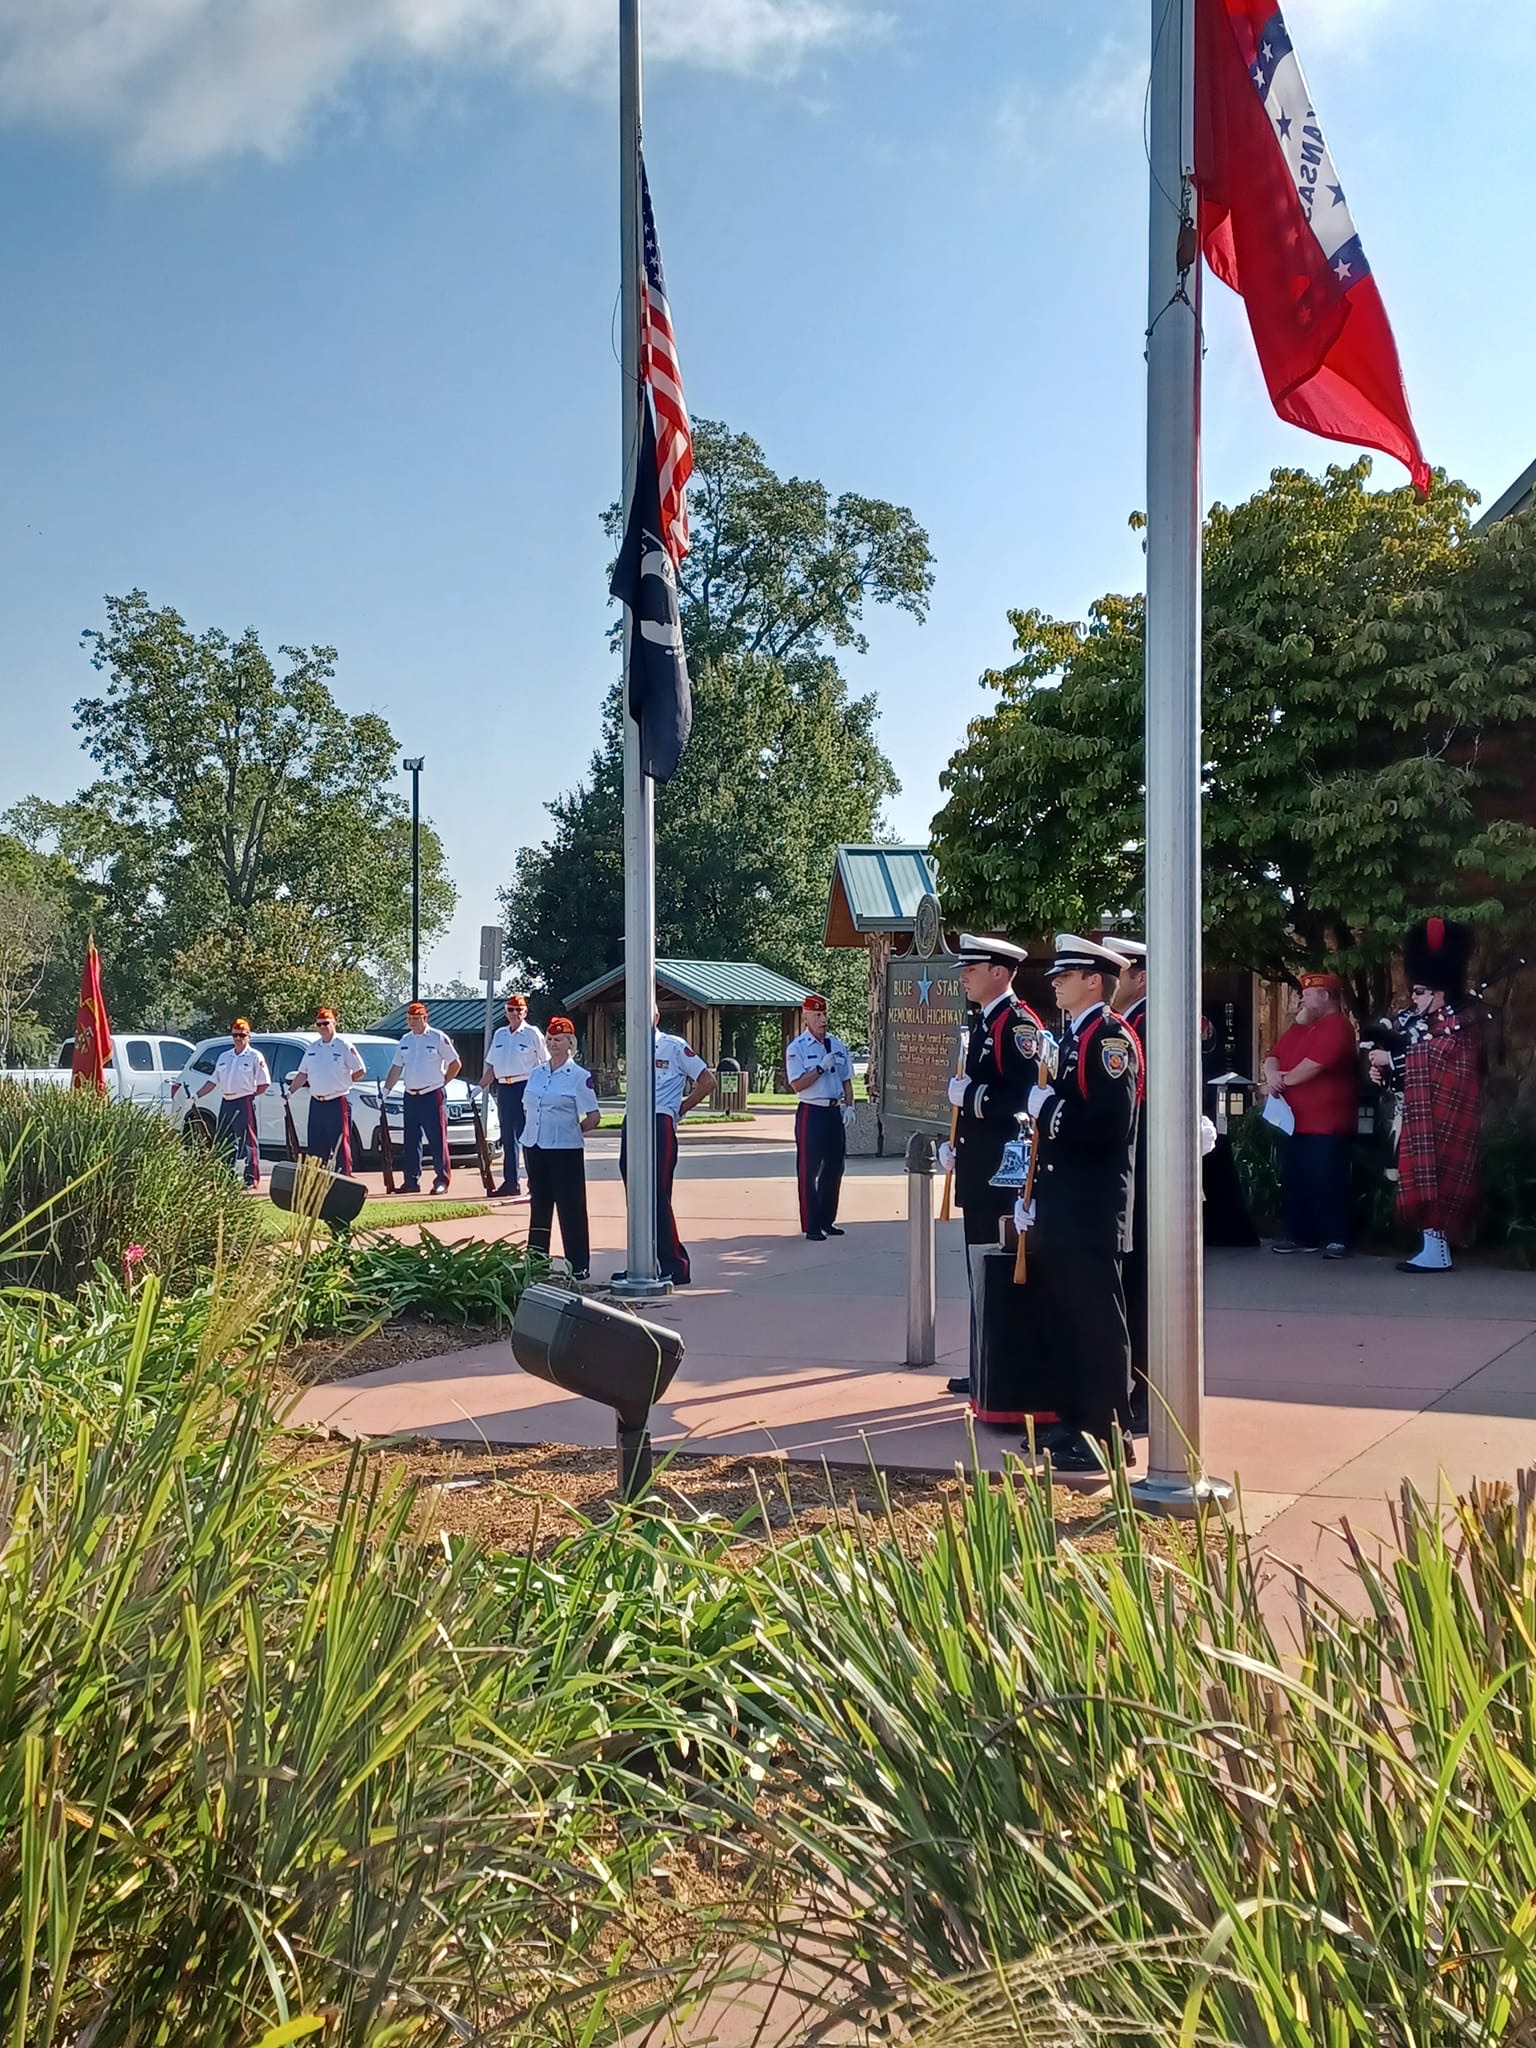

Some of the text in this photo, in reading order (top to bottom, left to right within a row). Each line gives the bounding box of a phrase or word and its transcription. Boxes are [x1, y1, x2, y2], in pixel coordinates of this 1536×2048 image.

[893, 979, 959, 997] BLUE STAR
[888, 1007, 964, 1025] MEMORIAL HIGHWAY
